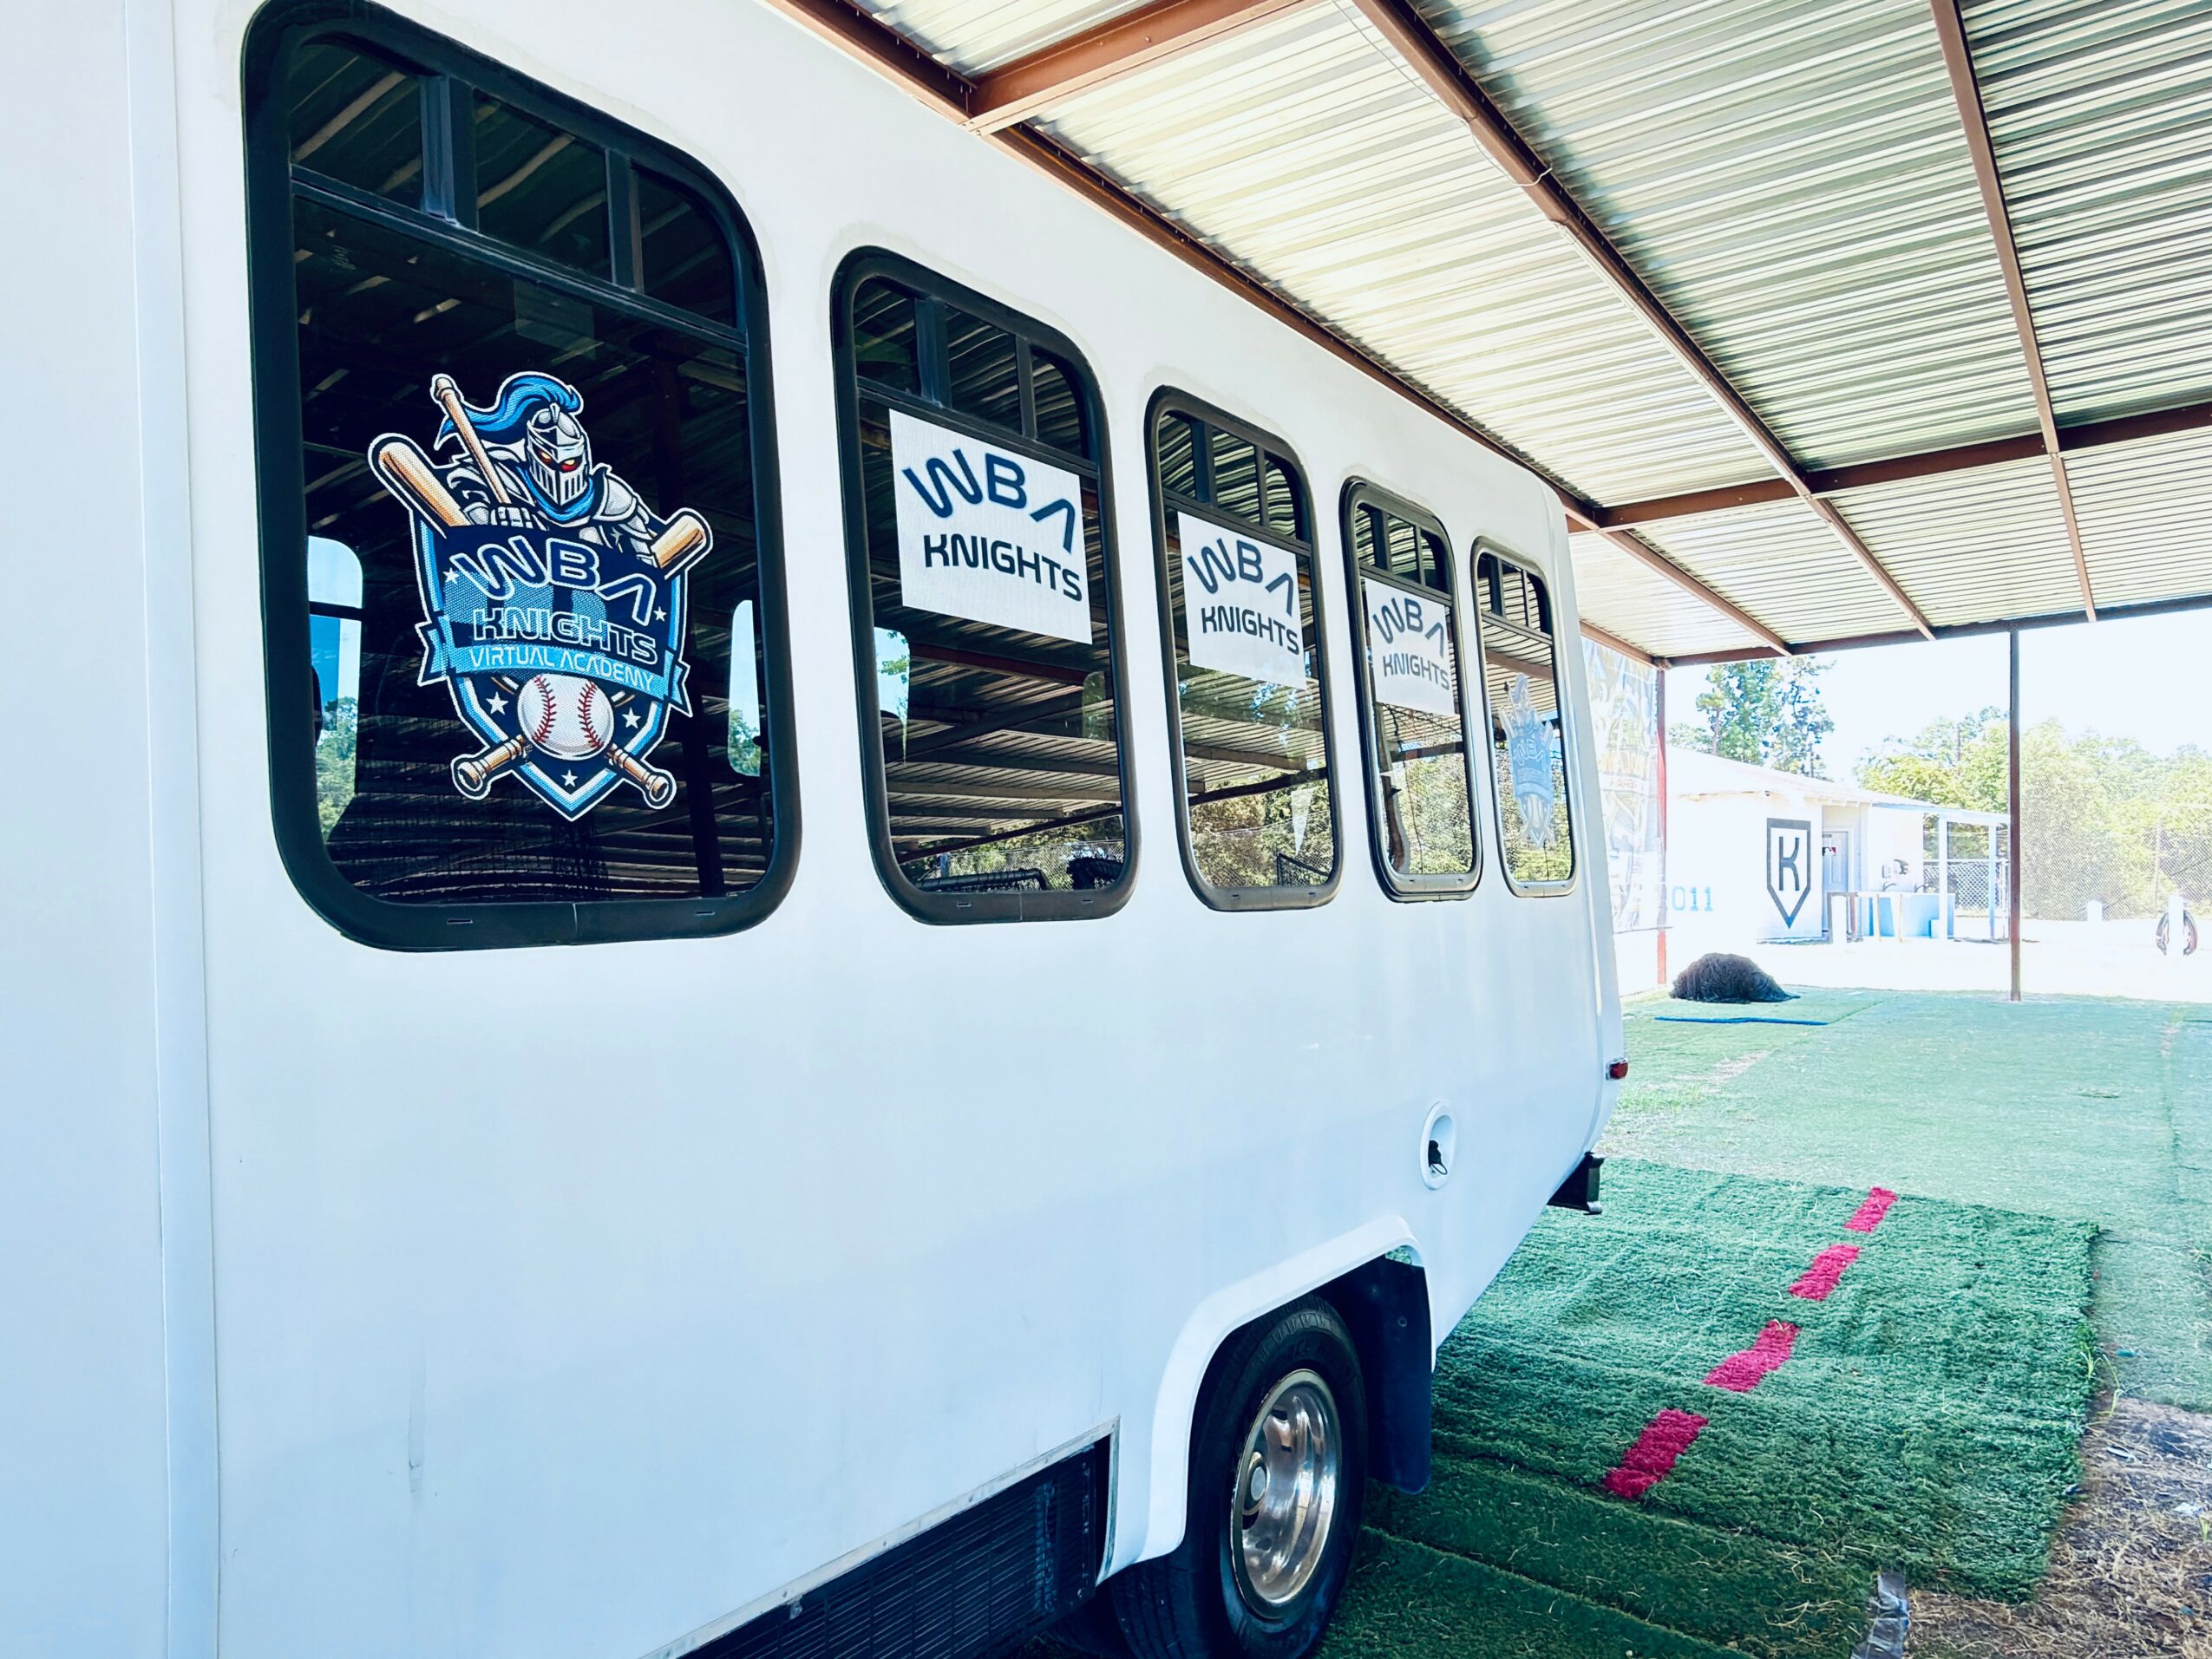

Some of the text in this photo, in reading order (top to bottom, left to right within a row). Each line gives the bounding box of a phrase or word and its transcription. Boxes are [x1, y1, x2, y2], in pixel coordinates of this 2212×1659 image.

[923, 533, 1083, 602] KNIGHTS
[473, 607, 658, 664] KNIGHTS
[1201, 605, 1300, 656] KNIGHTS
[468, 646, 654, 692] VIRTUAL ACADEMY
[1382, 652, 1450, 691] KNIGHTS
[1778, 836, 1800, 892] K
[1670, 885, 1714, 912] 011
